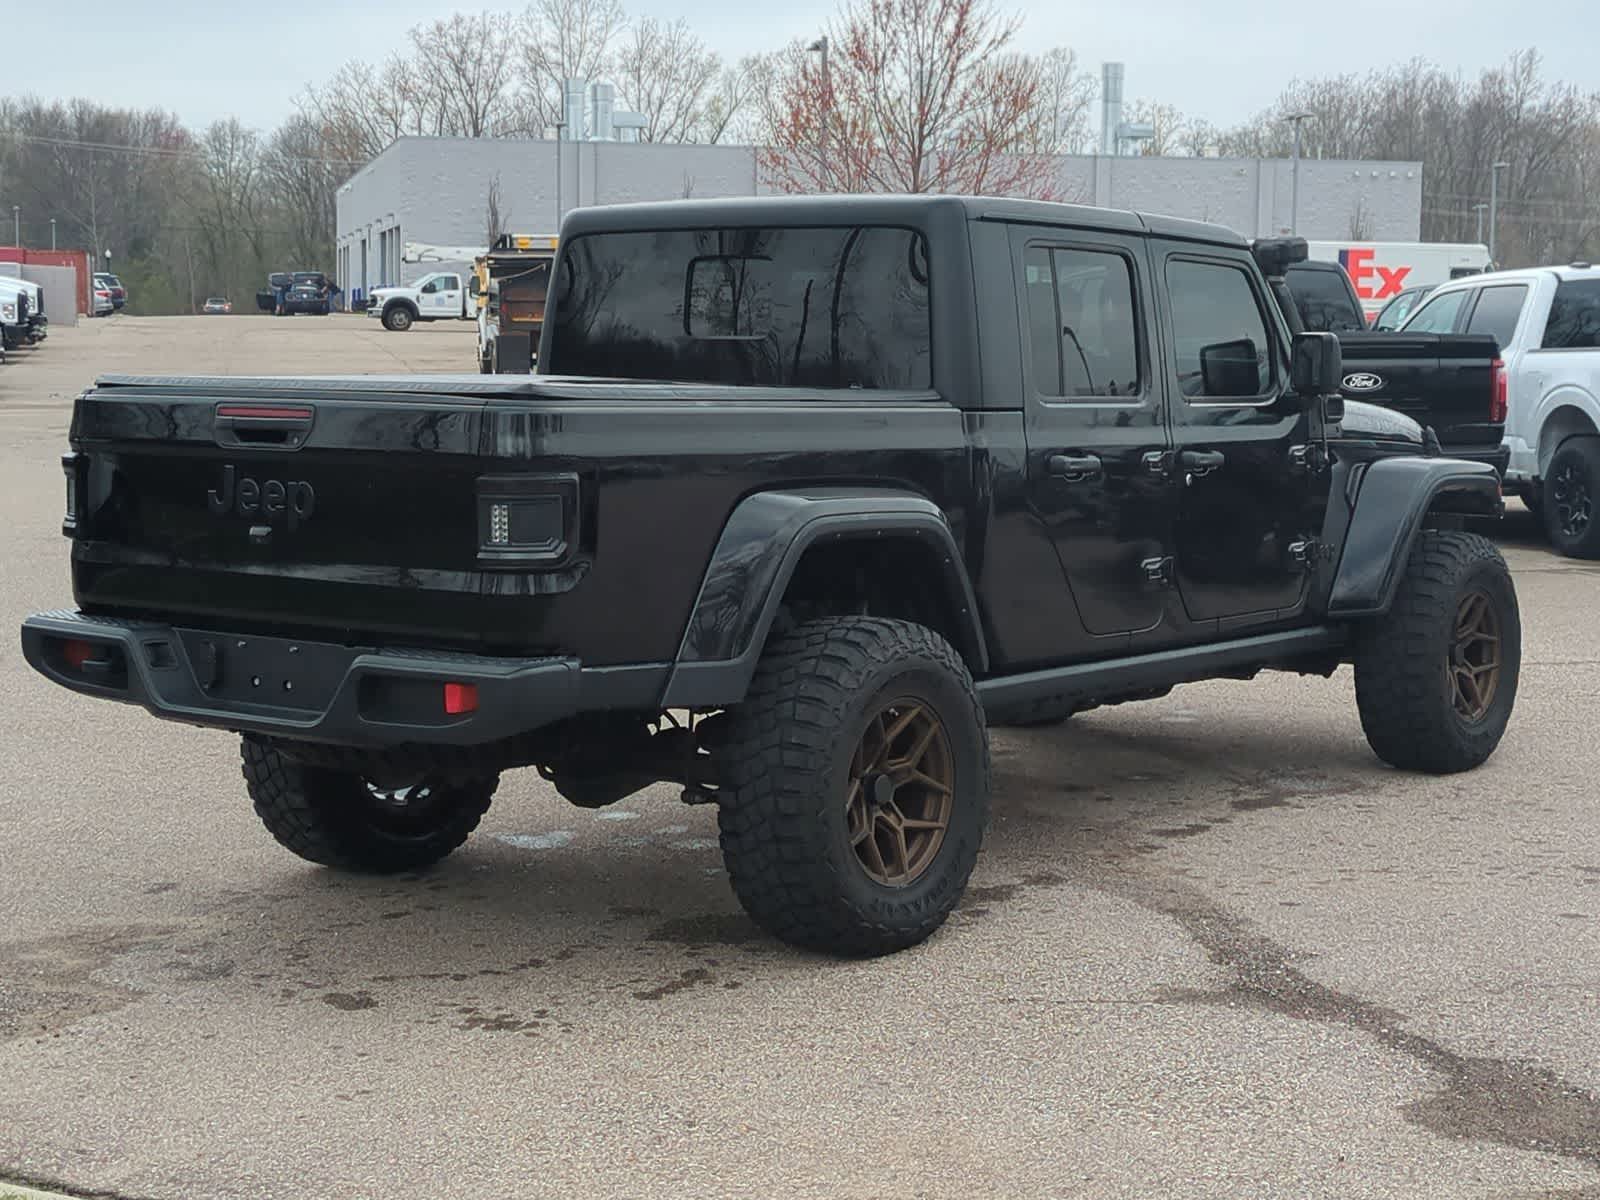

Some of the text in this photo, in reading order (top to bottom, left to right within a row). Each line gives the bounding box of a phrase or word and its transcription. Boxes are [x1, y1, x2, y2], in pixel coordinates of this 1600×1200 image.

[1339, 249, 1412, 298] Ex
[1349, 374, 1375, 387] Ford
[207, 464, 314, 530] Jeep
